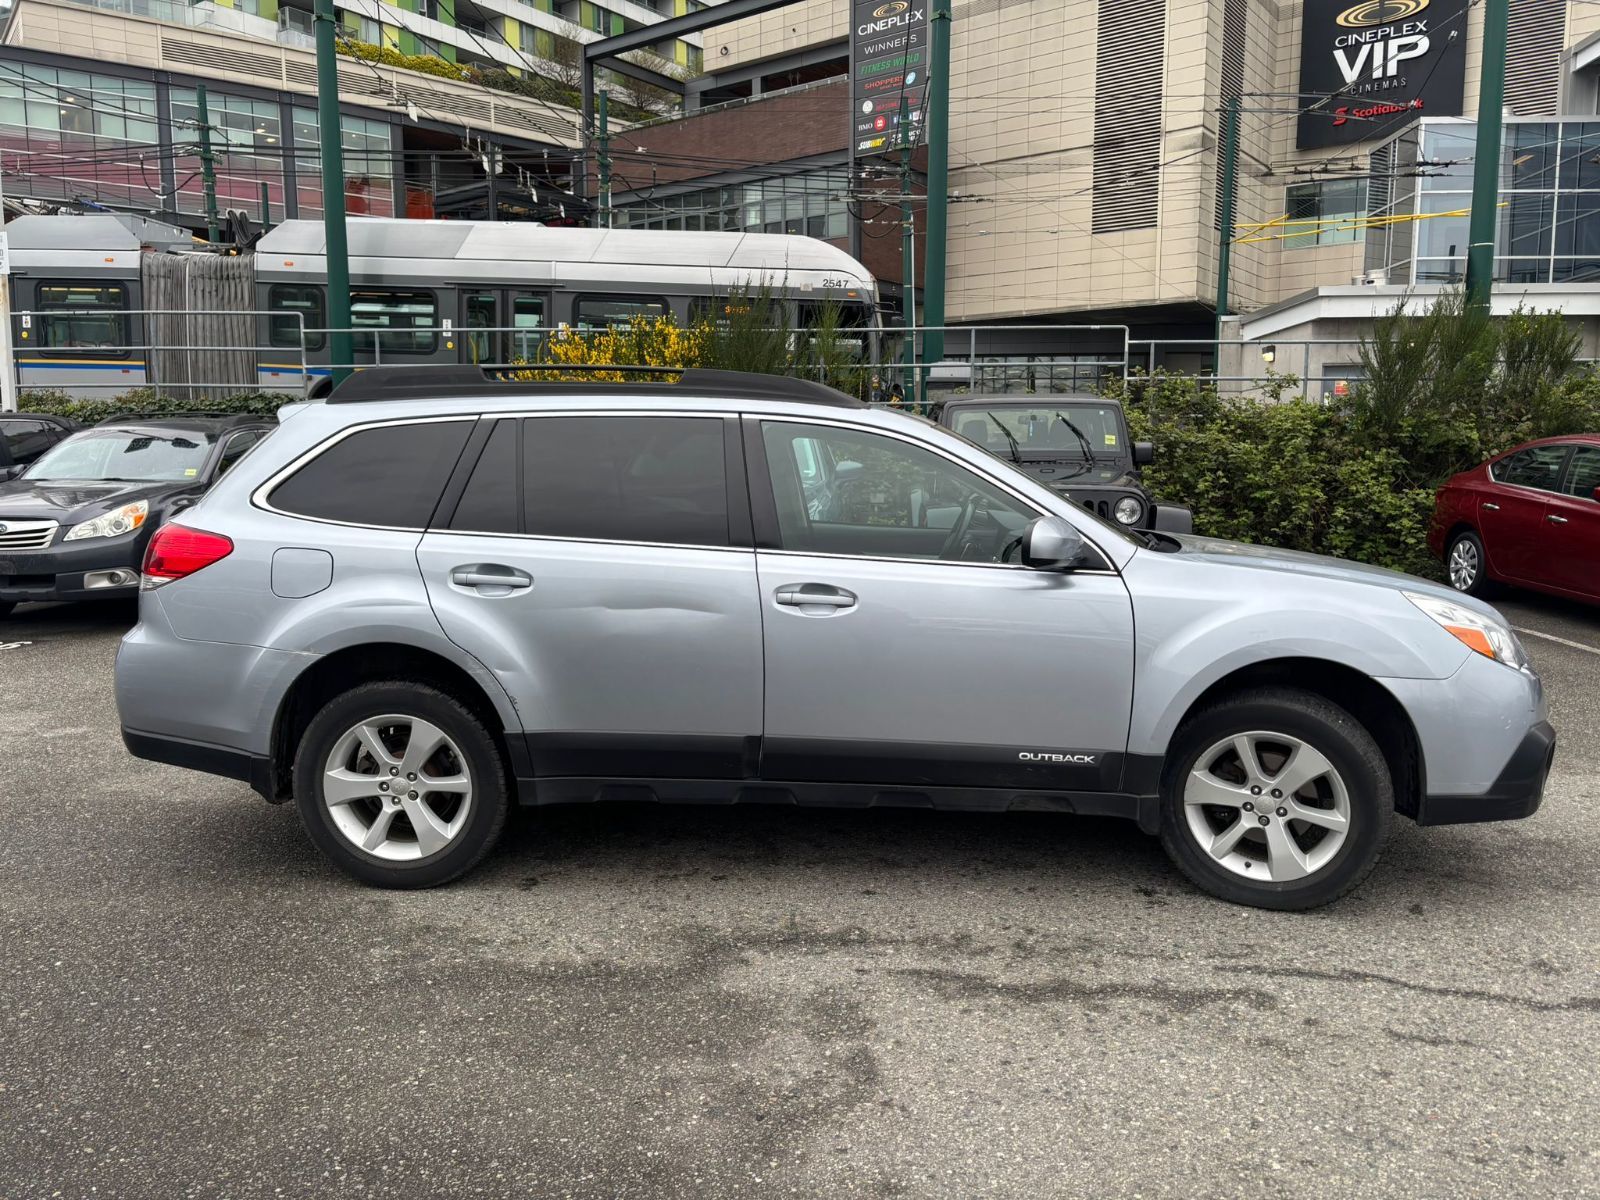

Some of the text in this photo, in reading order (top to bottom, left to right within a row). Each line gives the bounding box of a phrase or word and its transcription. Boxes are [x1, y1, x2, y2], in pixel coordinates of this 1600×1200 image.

[858, 9, 923, 35] CINEPLEX
[1335, 20, 1427, 48] CINEPLEX
[864, 34, 917, 55] WINNERS
[861, 60, 891, 75] FITNESS
[1333, 35, 1430, 84] VIP
[1351, 78, 1407, 95] CINEMAS
[1352, 98, 1424, 117] Scotiabk
[823, 278, 849, 288] 2547
[1018, 752, 1096, 764] OUTBACK
